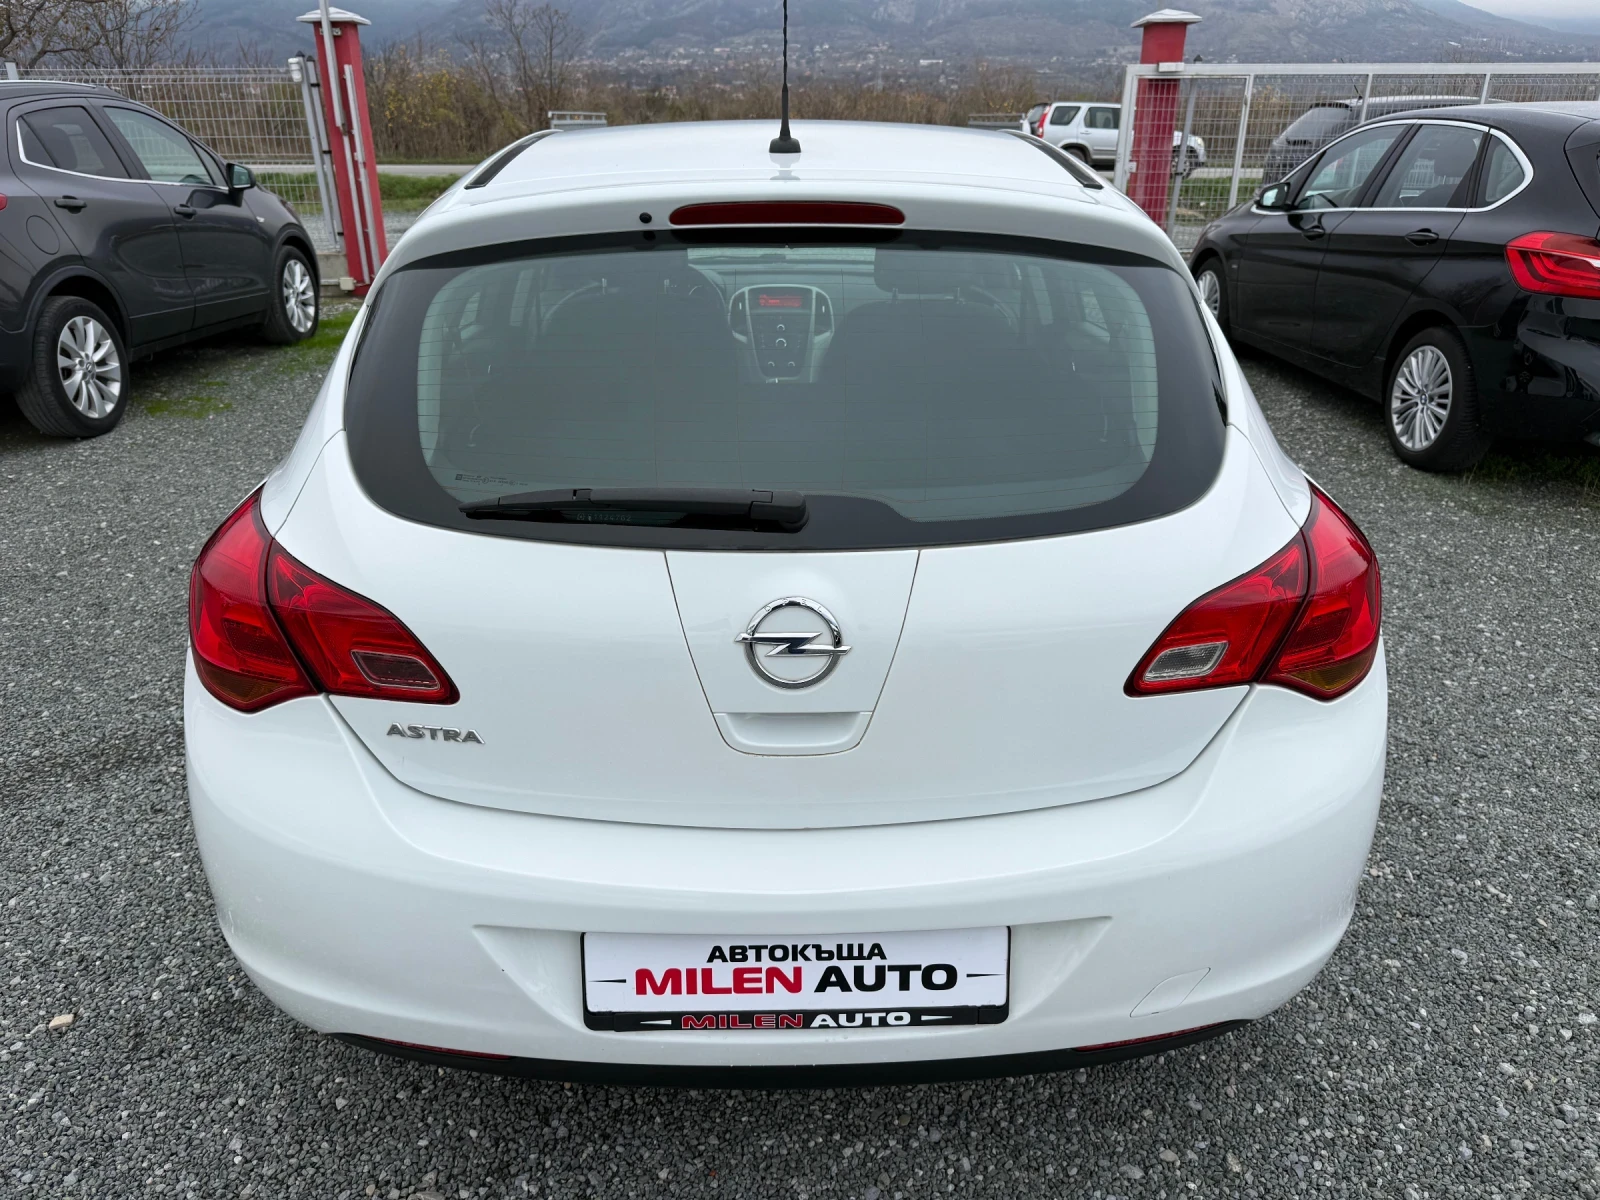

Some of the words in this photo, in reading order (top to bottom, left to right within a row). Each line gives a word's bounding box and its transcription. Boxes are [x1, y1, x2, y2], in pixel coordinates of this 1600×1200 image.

[386, 722, 485, 744] ASTRA
[635, 967, 803, 995] MILEN
[813, 964, 958, 993] AUTO
[681, 1013, 804, 1029] MILEN
[810, 1011, 912, 1028] AUTO
